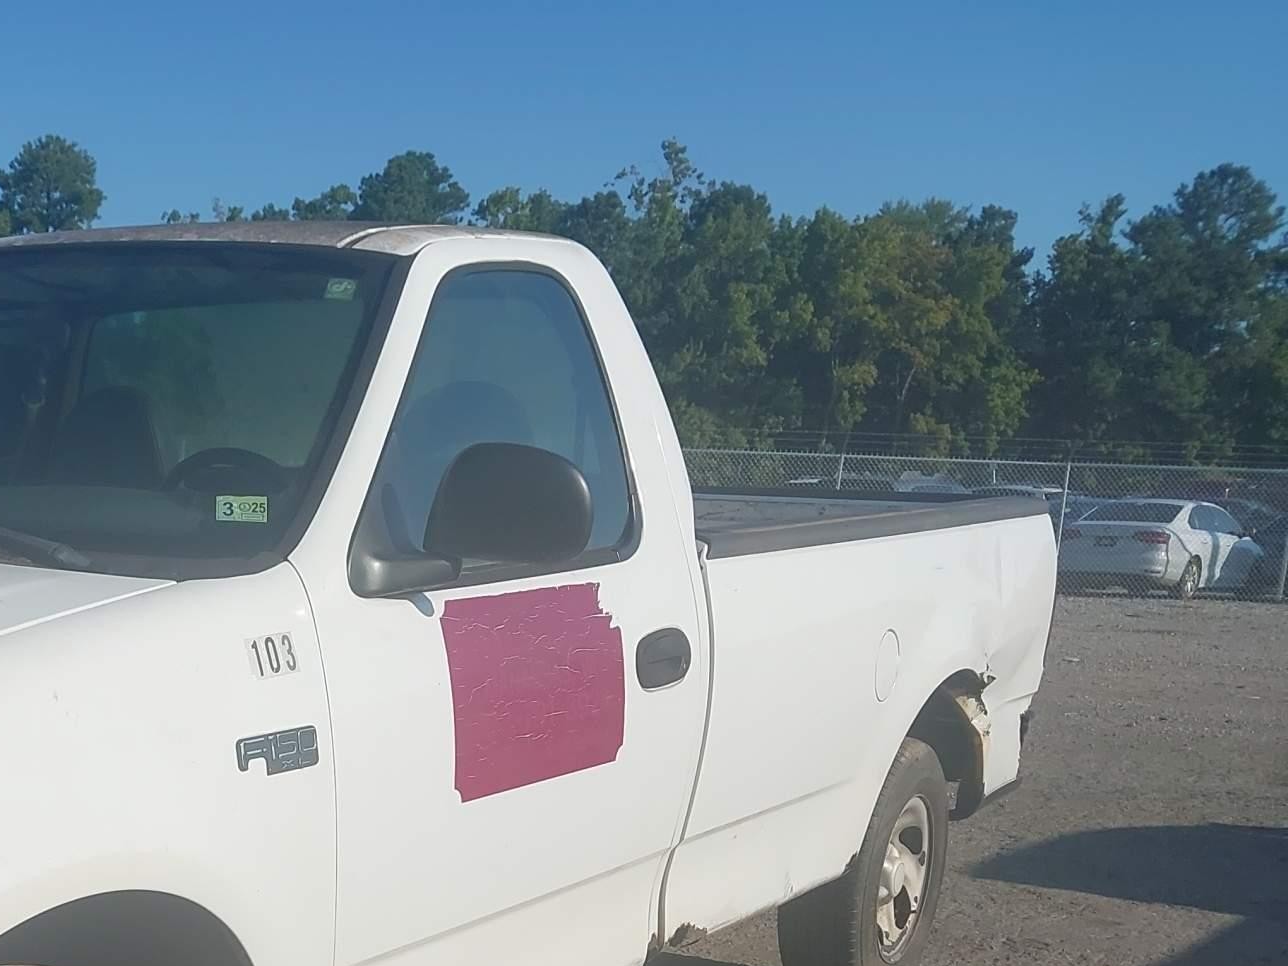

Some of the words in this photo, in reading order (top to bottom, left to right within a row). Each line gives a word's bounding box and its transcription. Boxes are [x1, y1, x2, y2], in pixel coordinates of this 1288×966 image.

[222, 501, 234, 516] 3
[251, 502, 266, 513] 25
[251, 634, 297, 677] 103
